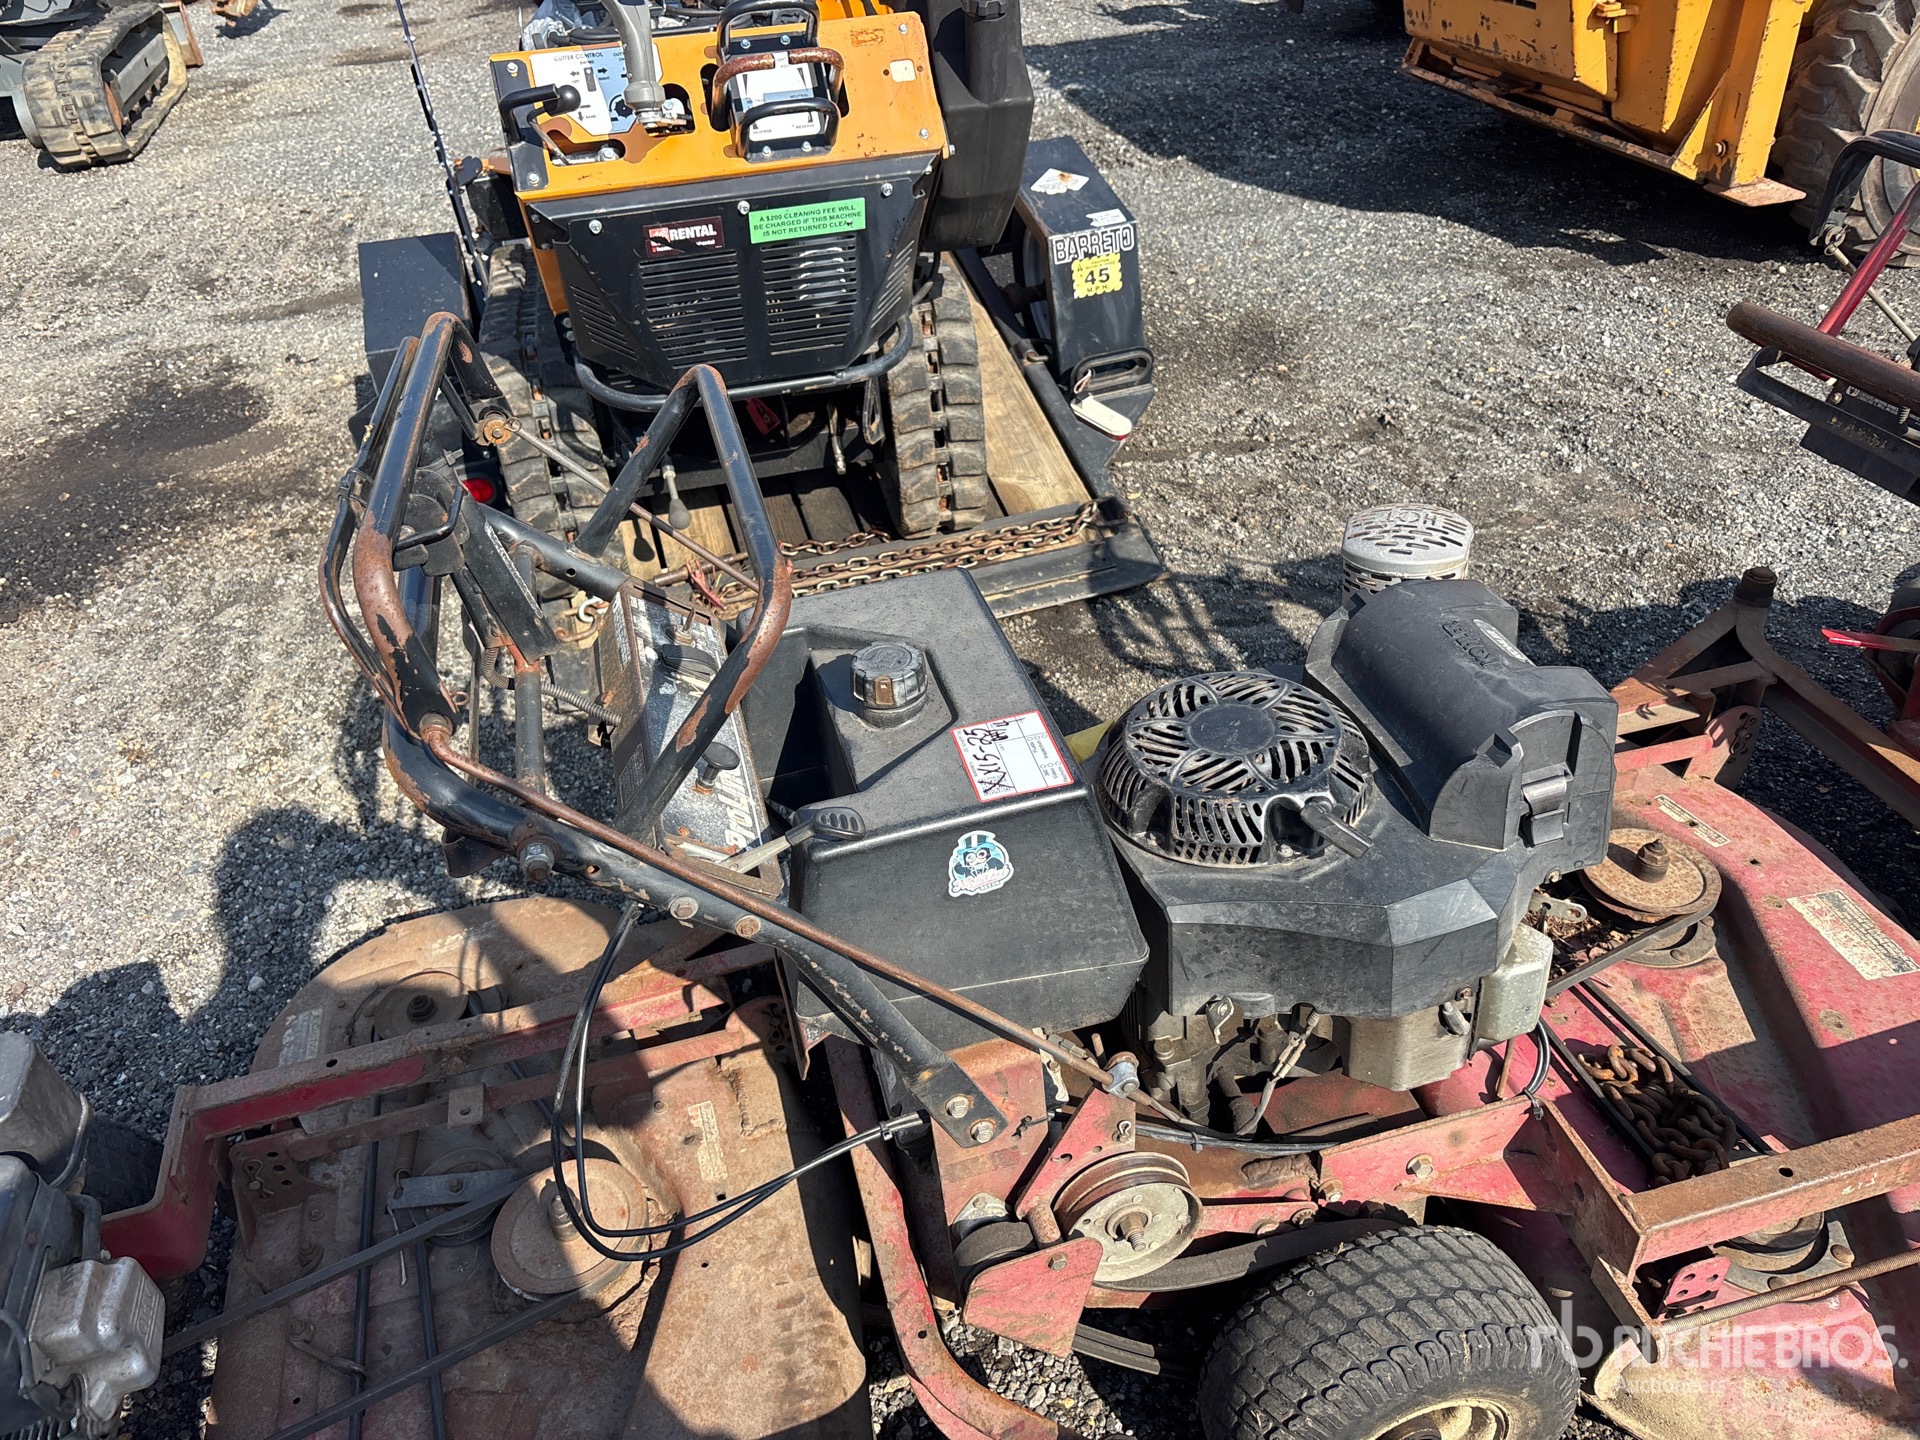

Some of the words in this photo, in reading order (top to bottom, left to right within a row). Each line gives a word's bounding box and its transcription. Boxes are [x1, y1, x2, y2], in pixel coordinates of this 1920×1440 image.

[554, 54, 574, 62] CUTTER
[575, 51, 604, 60] CONTROL
[765, 220, 801, 229] CHARGED
[829, 211, 862, 221] MACHINE
[784, 209, 821, 219] CLEANING
[669, 223, 718, 241] RENTAL
[788, 223, 828, 234] RETURNED
[1053, 224, 1134, 265] BARRETO
[1084, 267, 1110, 285] 45
